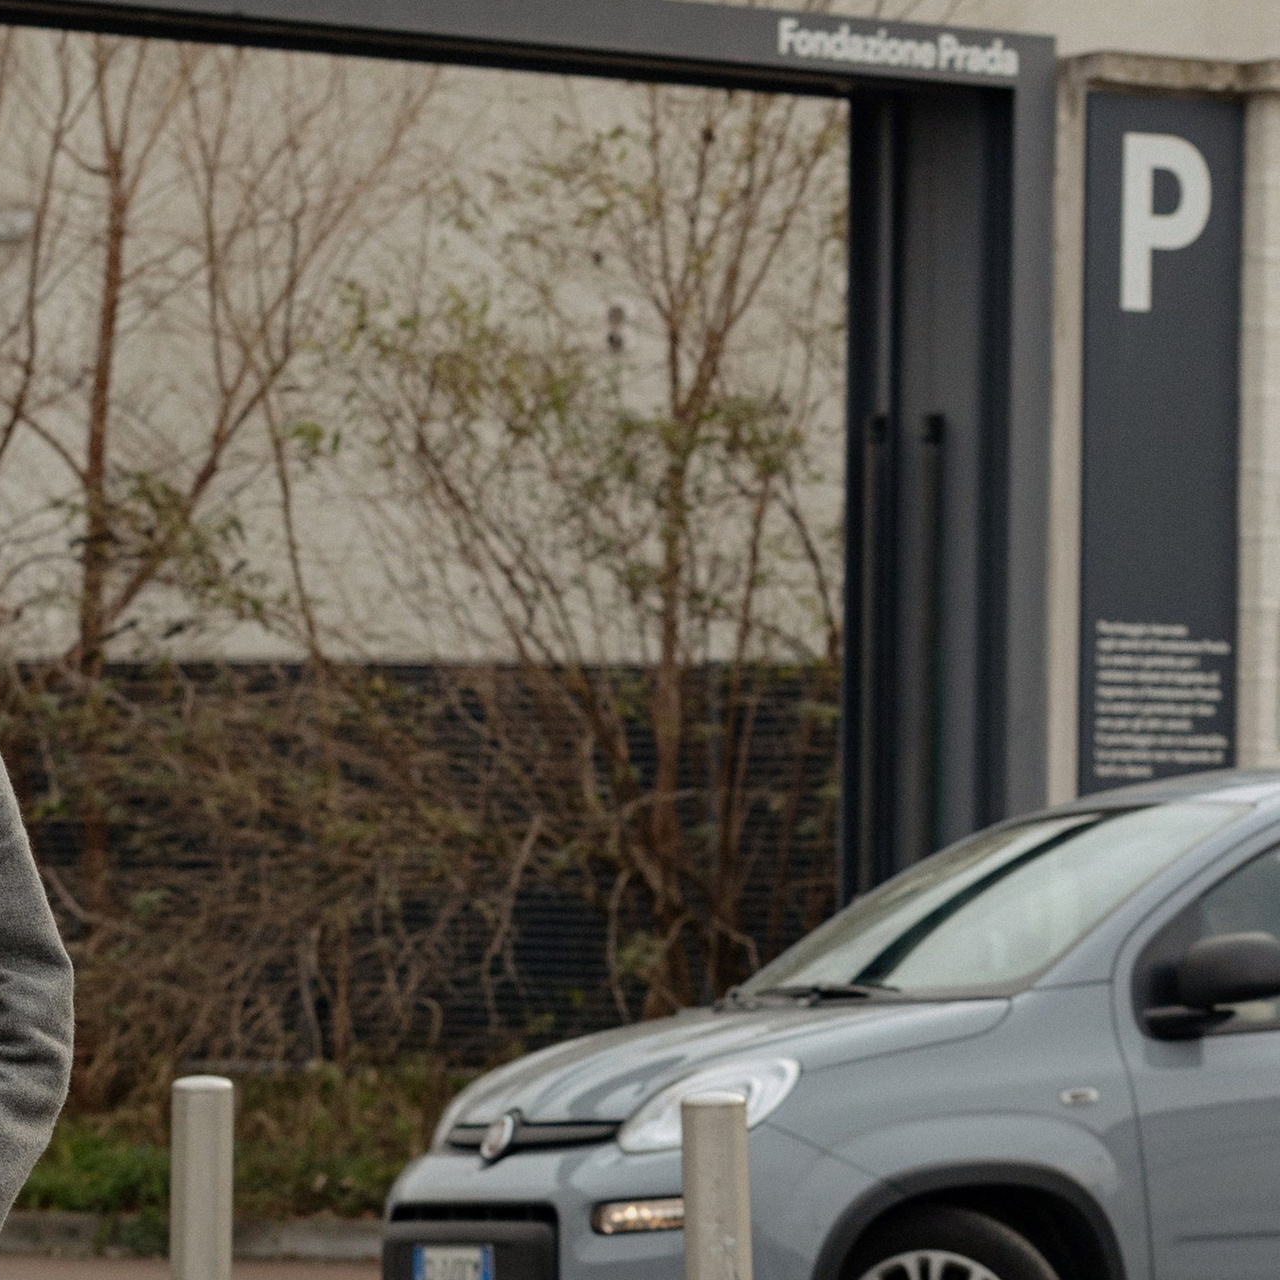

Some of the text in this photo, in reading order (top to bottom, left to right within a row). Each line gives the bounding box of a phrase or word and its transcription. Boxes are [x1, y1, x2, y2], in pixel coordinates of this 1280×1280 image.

[777, 18, 1019, 76] Fondazione Prada
[1120, 132, 1212, 313] P
